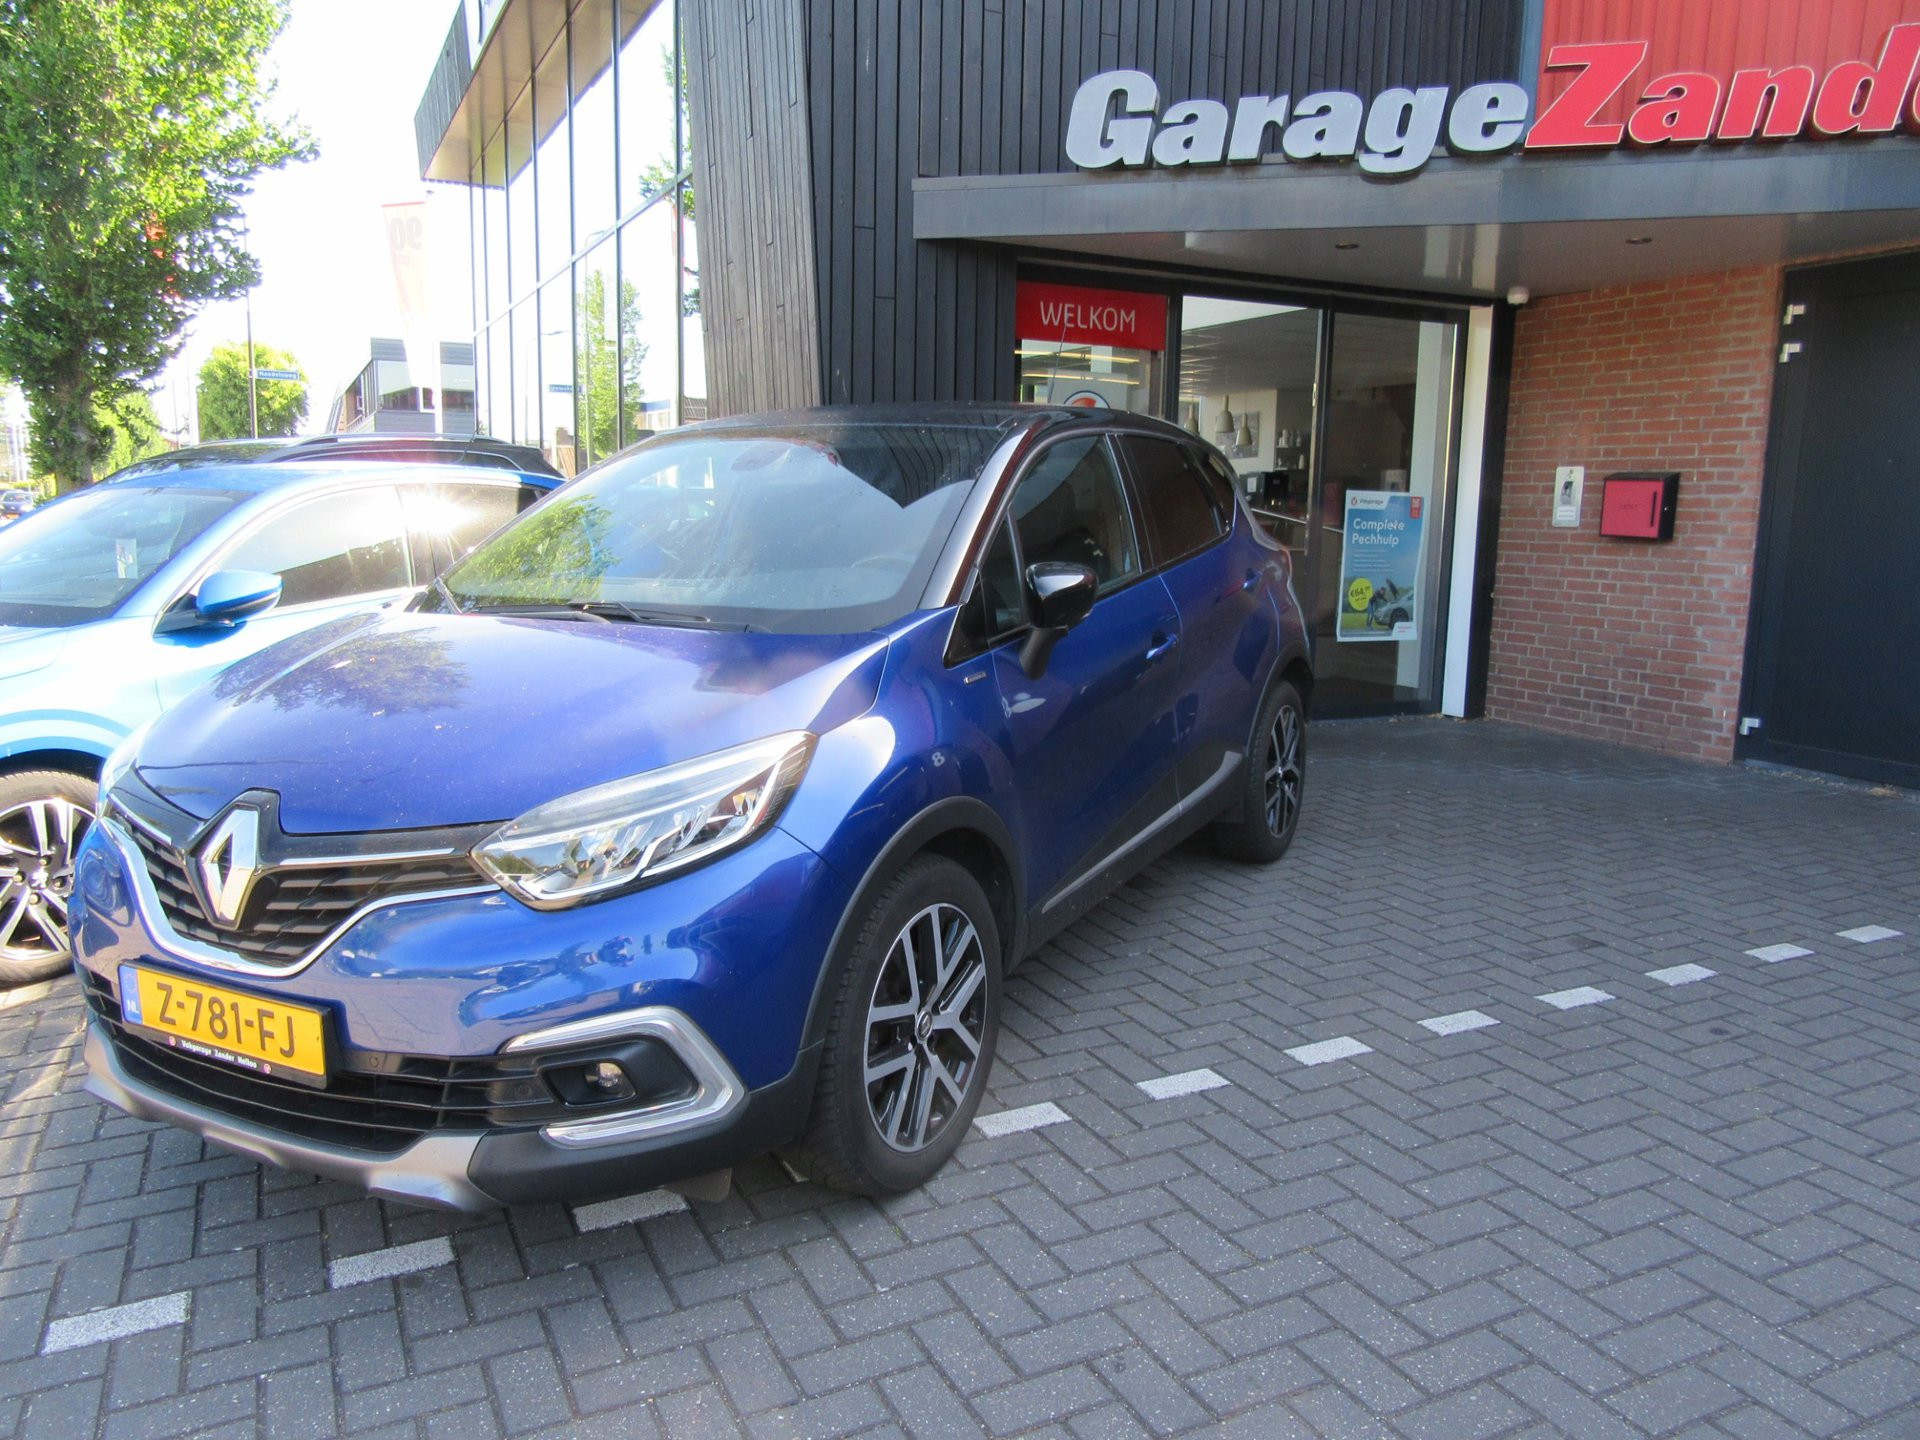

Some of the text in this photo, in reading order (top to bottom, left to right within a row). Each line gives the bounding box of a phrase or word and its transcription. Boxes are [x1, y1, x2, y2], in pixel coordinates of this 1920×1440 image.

[1066, 22, 1920, 177] Garage Zand
[1040, 301, 1136, 333] WELKOM
[1353, 518, 1405, 532] Complete
[1352, 533, 1399, 547] Pechhulp
[127, 999, 139, 1014] NL
[156, 982, 295, 1058] Z-781-FJ
